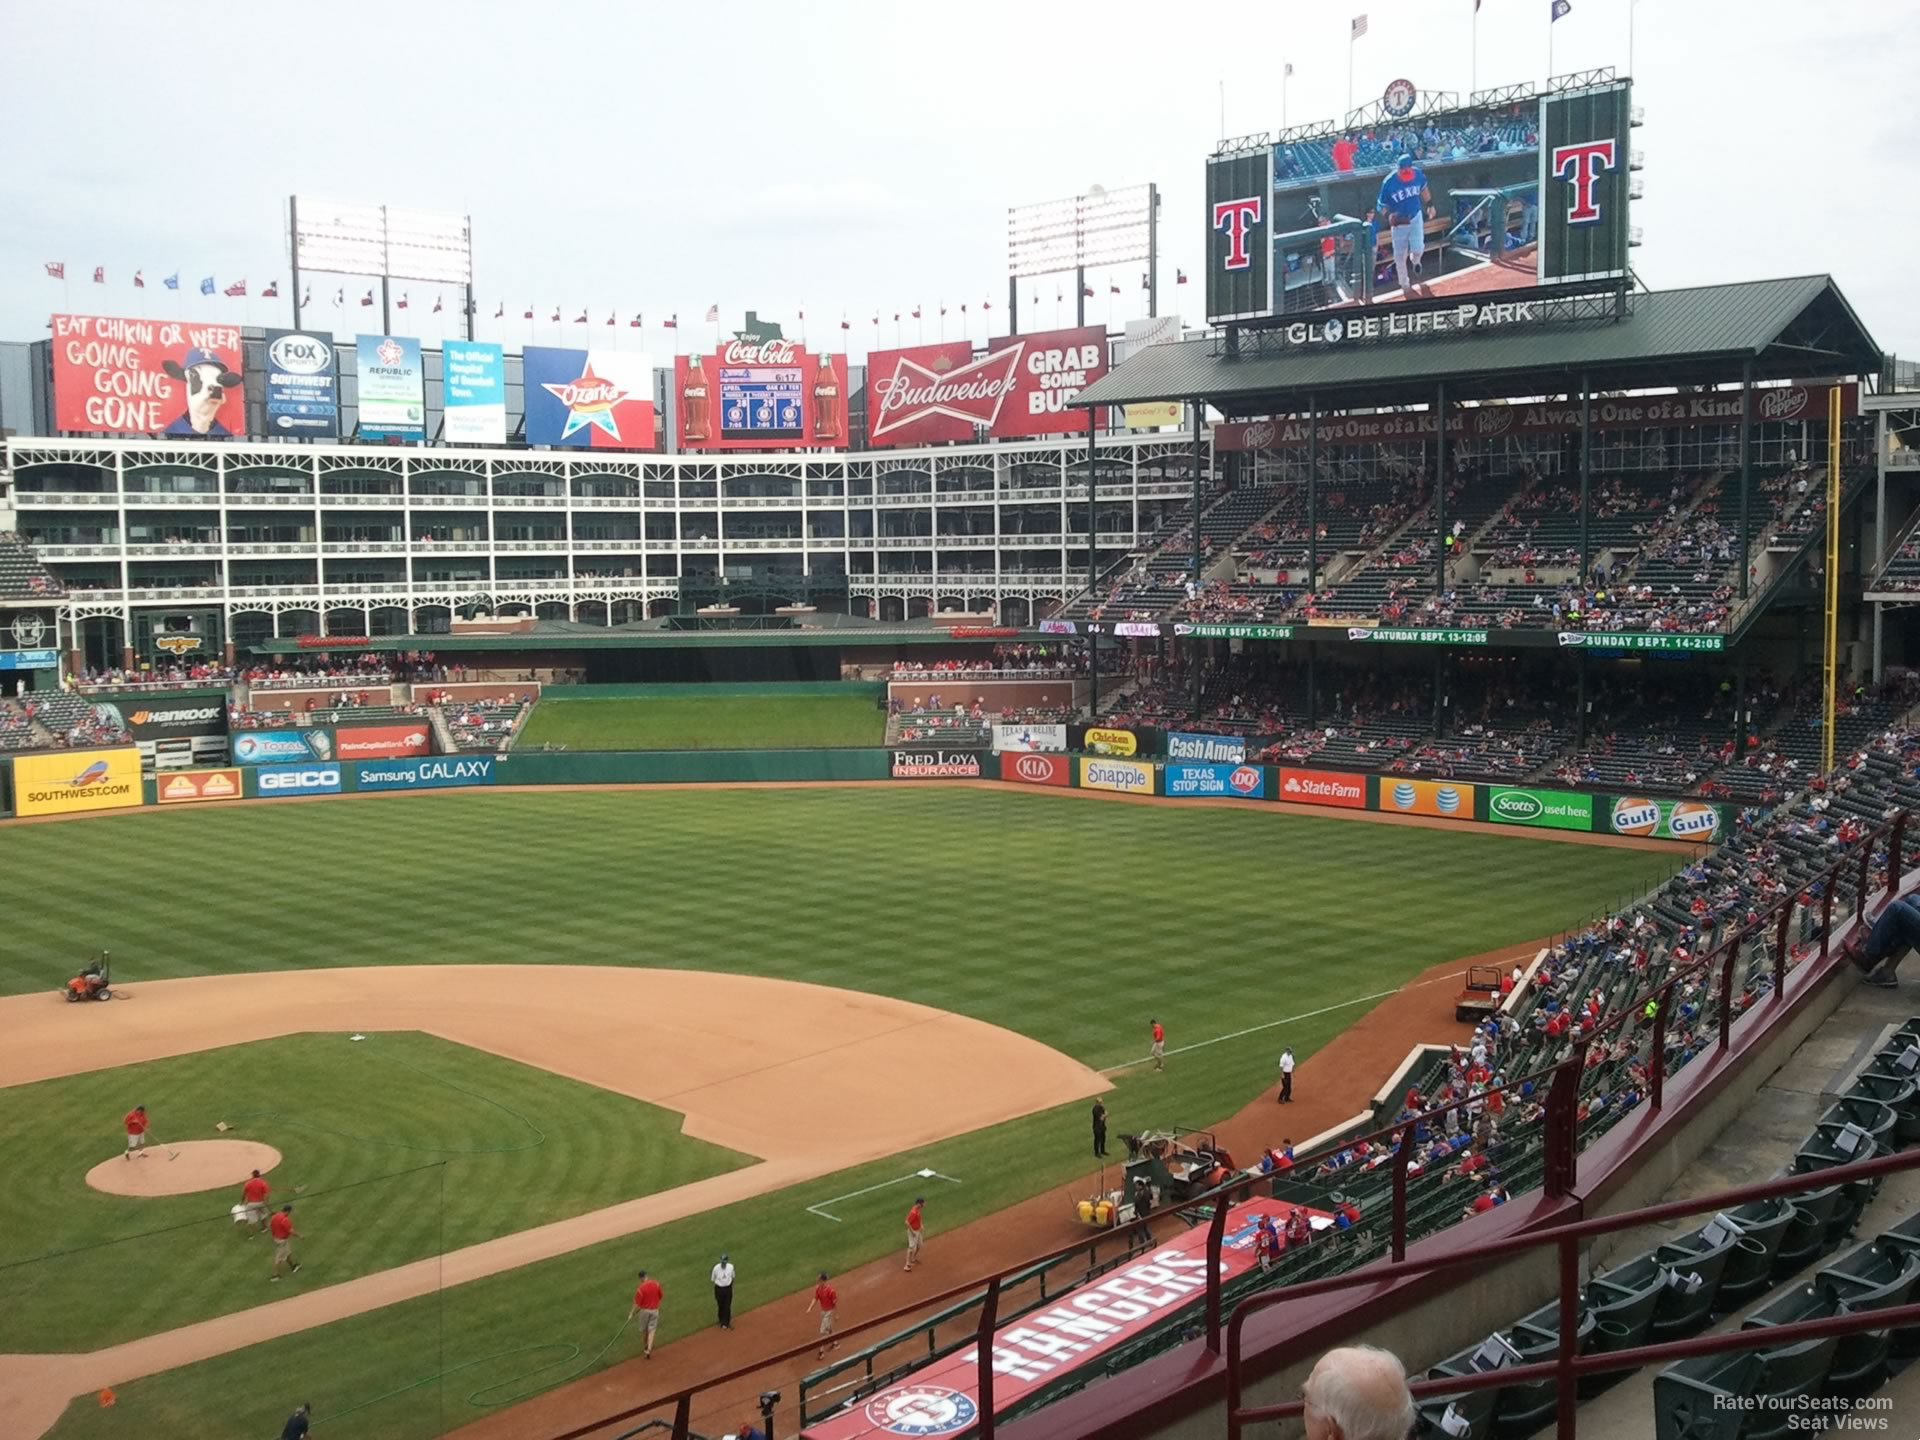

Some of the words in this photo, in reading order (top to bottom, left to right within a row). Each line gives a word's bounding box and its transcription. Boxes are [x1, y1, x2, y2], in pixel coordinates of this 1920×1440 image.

[1288, 316, 1380, 344] GLOBE
[1388, 309, 1449, 335] LIFE
[1458, 302, 1534, 328] PARK
[55, 316, 88, 338] EAT
[95, 318, 152, 347] CHIKIN
[160, 322, 184, 345] OR
[188, 326, 239, 353] WEER
[740, 333, 761, 341] Enjoy
[66, 341, 140, 370] GOING
[284, 343, 316, 360] FOX
[1027, 345, 1100, 375] GRAB
[270, 374, 332, 387] SOUTHWEST
[369, 367, 413, 376] REPUBLIC
[775, 374, 796, 382] 6:17
[1039, 370, 1087, 390] SOME
[94, 369, 172, 399] GOING
[875, 372, 1017, 411] Budweiser
[562, 384, 618, 407] Ozarka
[736, 399, 747, 407] 28
[763, 399, 774, 407] 29
[1760, 391, 1808, 417] Pepper
[86, 398, 164, 432] GONE
[1523, 405, 1599, 427] Always
[1601, 404, 1644, 421] One
[1647, 400, 1673, 421] of
[1673, 404, 1686, 418] a
[1690, 396, 1744, 418] Kind
[1345, 419, 1380, 438] One
[1384, 416, 1405, 435] of
[1406, 420, 1416, 433] a
[1196, 627, 1227, 636] FRIDAY
[1229, 628, 1254, 637] SEPT.
[1257, 628, 1290, 637] 12-7:05
[1372, 631, 1418, 641] SATURDAY
[1420, 631, 1446, 641] SEPT.
[1448, 632, 1487, 643] 13-12:05
[1586, 637, 1632, 647] SUNDAY
[1637, 638, 1671, 648] SEPT.
[1675, 638, 1721, 649] 14-2:05
[1001, 726, 1023, 737] TEXAS
[1024, 726, 1057, 737] IRELINE
[1092, 732, 1129, 744] Chicken
[260, 742, 305, 751] TOTAL
[1169, 737, 1204, 759] Cash
[893, 751, 935, 766] FRED
[937, 751, 979, 766] LOYA
[360, 769, 416, 784] Samsung
[419, 761, 490, 779] GALAXY
[893, 765, 979, 777] INSURANCE
[1022, 760, 1047, 776] KIA
[1087, 763, 1146, 789] Snapple
[1182, 768, 1215, 781] TEXAS
[259, 770, 340, 789] GEICO
[1173, 780, 1199, 793] STOP
[1200, 781, 1225, 793] SIGN
[1235, 773, 1255, 789] DQ
[28, 785, 130, 802] SOUTHWEST.COM
[1497, 797, 1536, 816] Scotts
[1544, 804, 1565, 817] used
[1567, 805, 1590, 819] here.
[1615, 808, 1657, 830] Gulf
[1671, 813, 1716, 836] Gulf
[960, 1249, 1230, 1382] RANGERS
